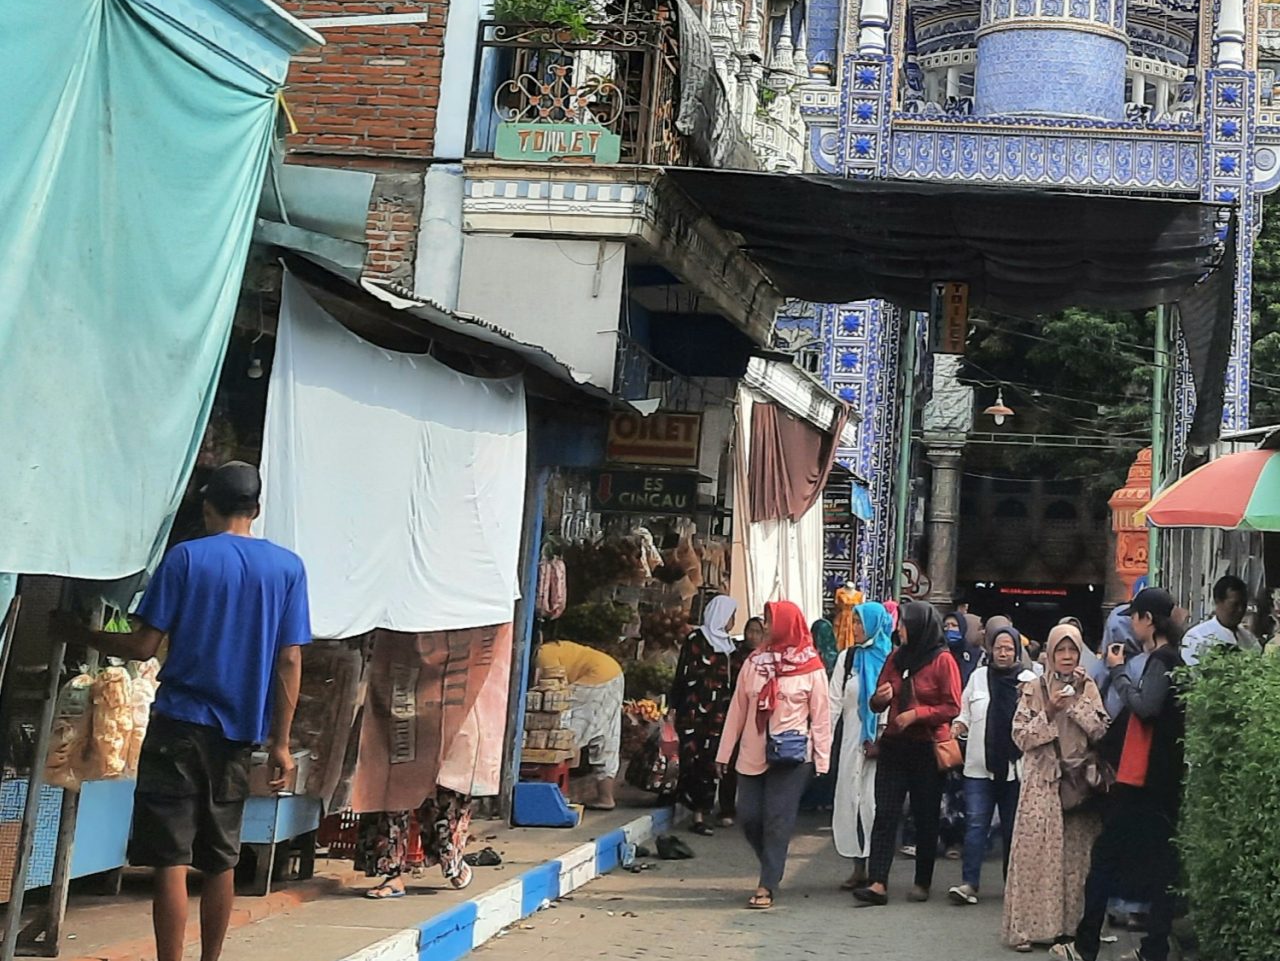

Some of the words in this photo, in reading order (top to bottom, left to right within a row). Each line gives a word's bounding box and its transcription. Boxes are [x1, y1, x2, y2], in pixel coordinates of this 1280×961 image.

[518, 130, 602, 153] TOILET
[950, 284, 962, 350] TOILET
[610, 414, 697, 441] OILET
[643, 477, 664, 491] ES
[619, 493, 686, 508] CINCAU
